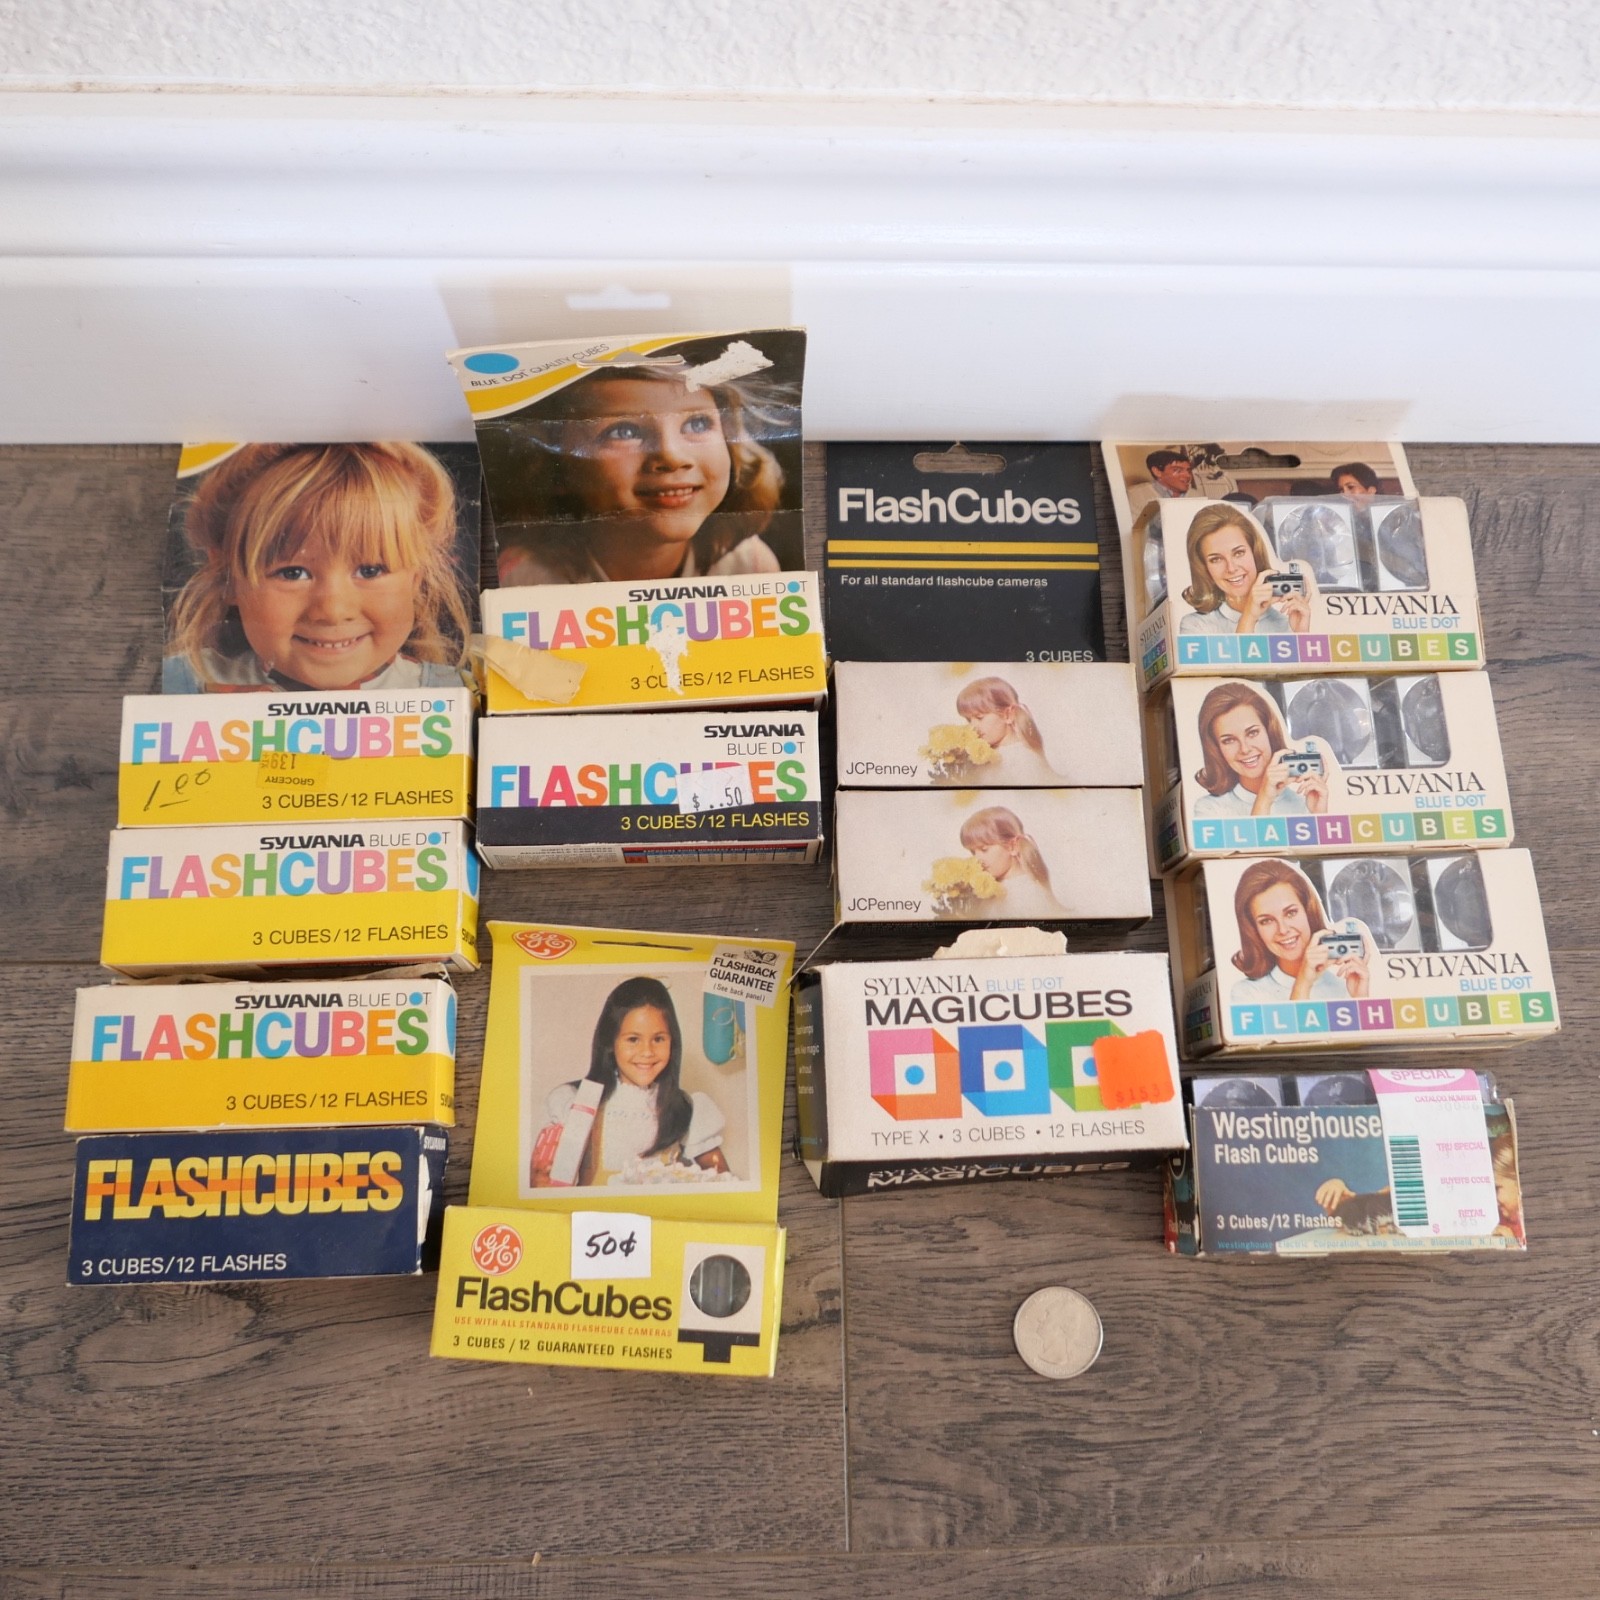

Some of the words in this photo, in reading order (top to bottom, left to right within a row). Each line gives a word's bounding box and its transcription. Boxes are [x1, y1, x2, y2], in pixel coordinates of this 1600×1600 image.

[471, 378, 500, 387] BLUE
[502, 369, 529, 382] DOT
[530, 357, 571, 373] QUALITY
[572, 344, 610, 360] CUBES
[838, 487, 1082, 525] FlashCubes
[628, 585, 728, 602] SYLVANIA
[731, 584, 771, 598] BLUE
[775, 580, 808, 594] DOT
[841, 575, 862, 585] For
[864, 575, 878, 585] all
[881, 575, 934, 586] standard
[936, 575, 994, 587] flashcube
[997, 577, 1048, 587] cameras
[1326, 594, 1460, 616] SYLVANIA
[501, 595, 811, 650] FLASHCUBES
[1392, 617, 1428, 630] BLUE
[1431, 616, 1460, 629] DOT
[1026, 651, 1035, 663] 3
[1038, 649, 1094, 663] CUBES
[1186, 636, 1477, 660] FLASHCUBES
[630, 677, 640, 690] 3
[646, 670, 733, 689] CUES/12
[738, 666, 814, 684] FLASHES
[267, 701, 371, 717] SYLVANIA
[376, 701, 416, 713] BLUE
[420, 700, 455, 713] DOT
[131, 715, 453, 765] FLASHCUBES
[704, 724, 805, 738] SYLVANIA
[727, 743, 768, 756] BLUE
[771, 741, 806, 755] DOT
[265, 776, 315, 786] GROCERY
[846, 762, 918, 778] JCPenney
[491, 760, 808, 808] FLASHCES
[1347, 771, 1487, 796] SYLVANIA
[262, 796, 272, 809] 3
[374, 790, 454, 806] FLASHES
[1415, 795, 1452, 809] BLUE
[1455, 794, 1487, 808] DOT
[621, 818, 631, 830] 3
[732, 812, 809, 828] FLASHES
[1203, 815, 1498, 843] FLASHCUBES
[260, 834, 366, 850] SYLVANIA
[369, 834, 412, 847] BLUE
[416, 831, 451, 846] DOT
[120, 847, 448, 900] FLASHCUBES
[848, 898, 922, 914] JCPenney
[253, 932, 262, 945] 3
[368, 925, 449, 942] FLASHES
[713, 957, 778, 979] FLASHBACK
[1388, 952, 1531, 980] SYLVANIA
[710, 968, 774, 993] GUARANTEE
[864, 974, 980, 997] SYLVANIA
[986, 978, 1027, 993] BLUE
[1032, 977, 1064, 991] DOT
[1460, 977, 1497, 992] BLUE
[1501, 976, 1533, 990] DOT
[235, 993, 343, 1009] SYLVANIA
[348, 994, 391, 1007] BLUE
[396, 992, 432, 1006] DOT
[713, 983, 728, 993] (See
[730, 986, 744, 996] back
[746, 992, 766, 1003] panel)
[864, 989, 1133, 1026] MAGICUBES
[1241, 999, 1544, 1030] FLASHCUBES
[91, 1008, 429, 1062] FLASHCUBES
[1391, 1069, 1456, 1080] SPECIAL
[227, 1096, 237, 1110] 3
[344, 1090, 428, 1107] FLASHES
[872, 1130, 912, 1147] TYPE
[919, 1130, 930, 1144] X
[952, 1129, 962, 1144] 3
[968, 1125, 1026, 1142] CUBES
[1048, 1124, 1064, 1139] 12
[1071, 1121, 1145, 1137] FLASHES
[1211, 1111, 1383, 1143] Westinghouse
[1215, 1145, 1260, 1163] Flash
[1266, 1144, 1319, 1163] Cubes
[1454, 1141, 1486, 1150] SPECIAL
[84, 1151, 404, 1221] FLASHCUBES
[867, 1162, 1131, 1188] MAGICUBES
[1217, 1215, 1224, 1230] 3
[1294, 1213, 1342, 1228] Flashes
[1458, 1209, 1486, 1218] RETAIL
[585, 1231, 637, 1259] 50¢
[1217, 1240, 1272, 1250] Westinghouse
[81, 1261, 93, 1276] 3
[200, 1253, 287, 1273] FLASHES
[455, 1276, 673, 1321] FlashCubes
[454, 1316, 473, 1325] USE
[475, 1317, 498, 1327] WITH
[501, 1319, 516, 1328] ALL
[519, 1320, 569, 1332] STANDARD
[572, 1323, 625, 1336] FLASHCUBE
[628, 1327, 673, 1338] CAMERAS
[453, 1336, 460, 1347] 3
[537, 1340, 615, 1356] GUARANTEED
[621, 1347, 673, 1360] FLASHES
